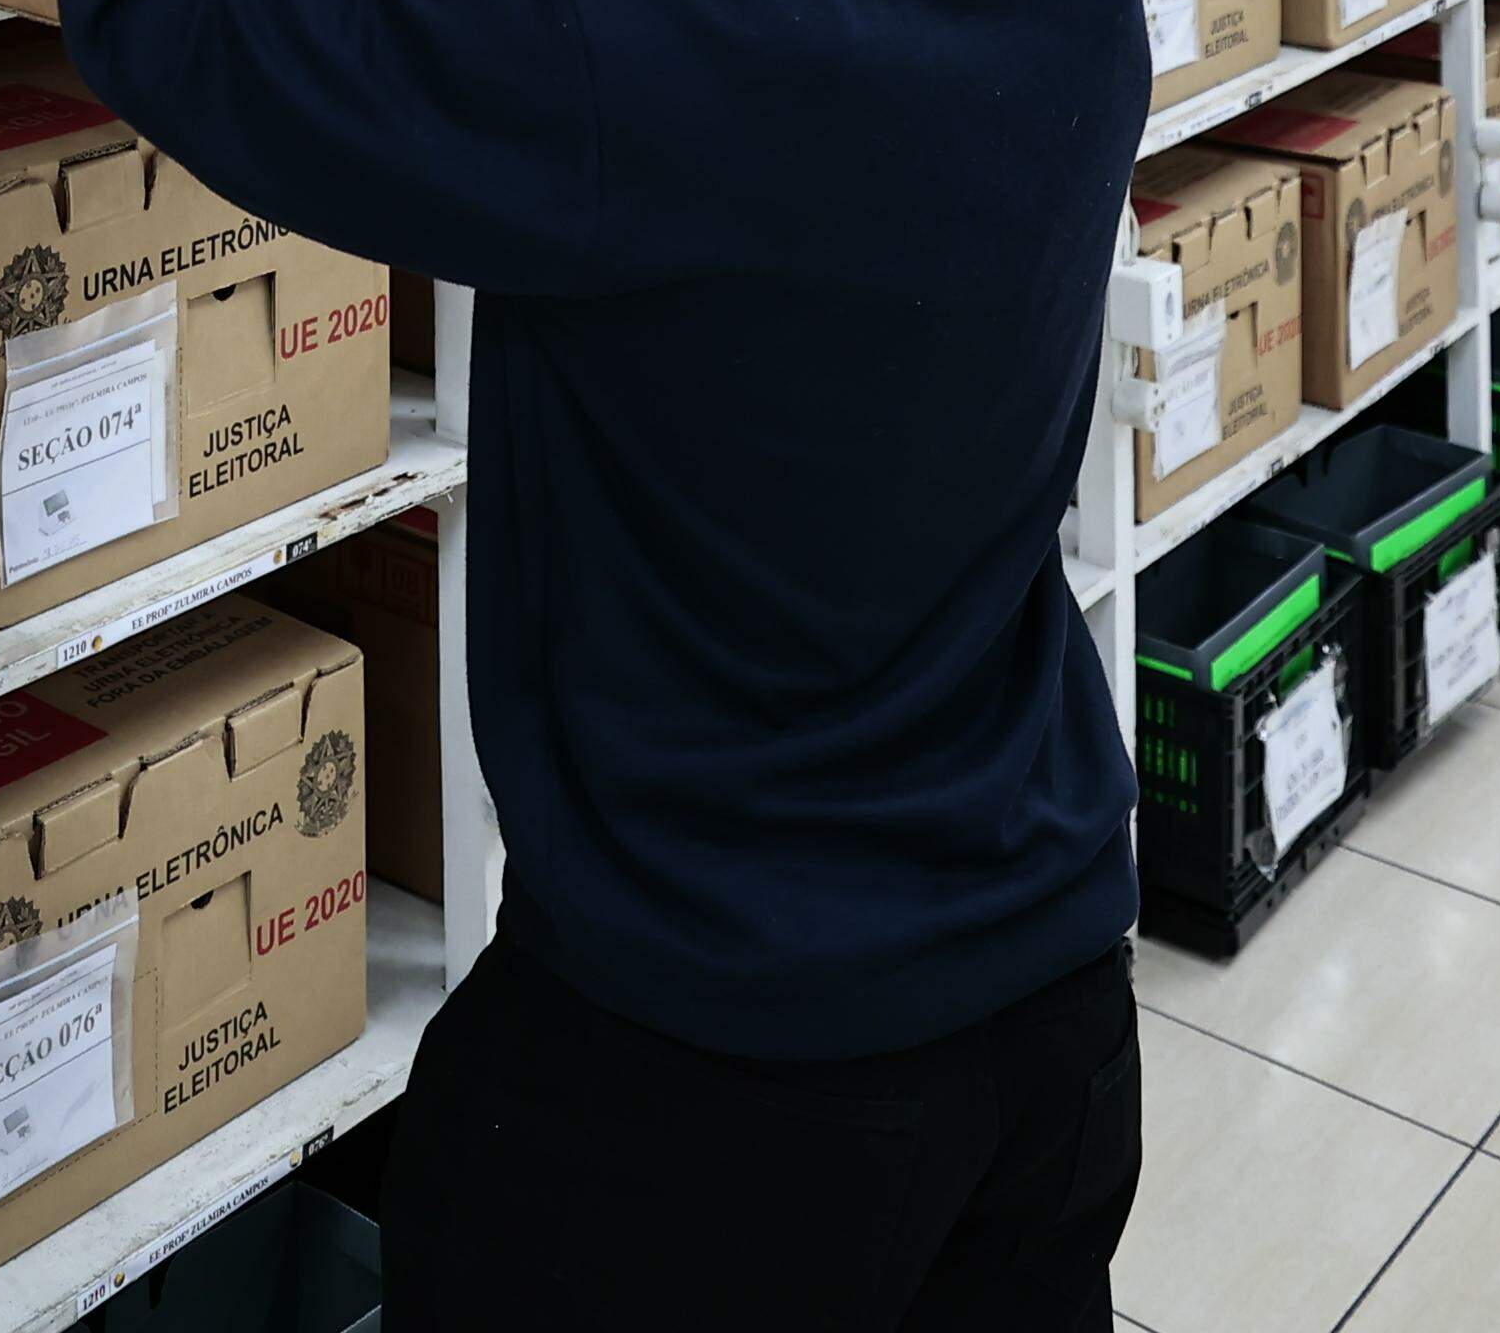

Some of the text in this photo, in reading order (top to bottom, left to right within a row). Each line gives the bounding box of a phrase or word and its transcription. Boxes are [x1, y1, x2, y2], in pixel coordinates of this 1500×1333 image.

[280, 295, 388, 359] UE 2020
[18, 403, 143, 473] SEÇÃO 074ª
[132, 615, 144, 629] EE
[174, 583, 215, 616] ZULMIRA
[217, 568, 252, 594] CAMPOS
[62, 640, 87, 661] 1210
[58, 1002, 102, 1051] 076ª
